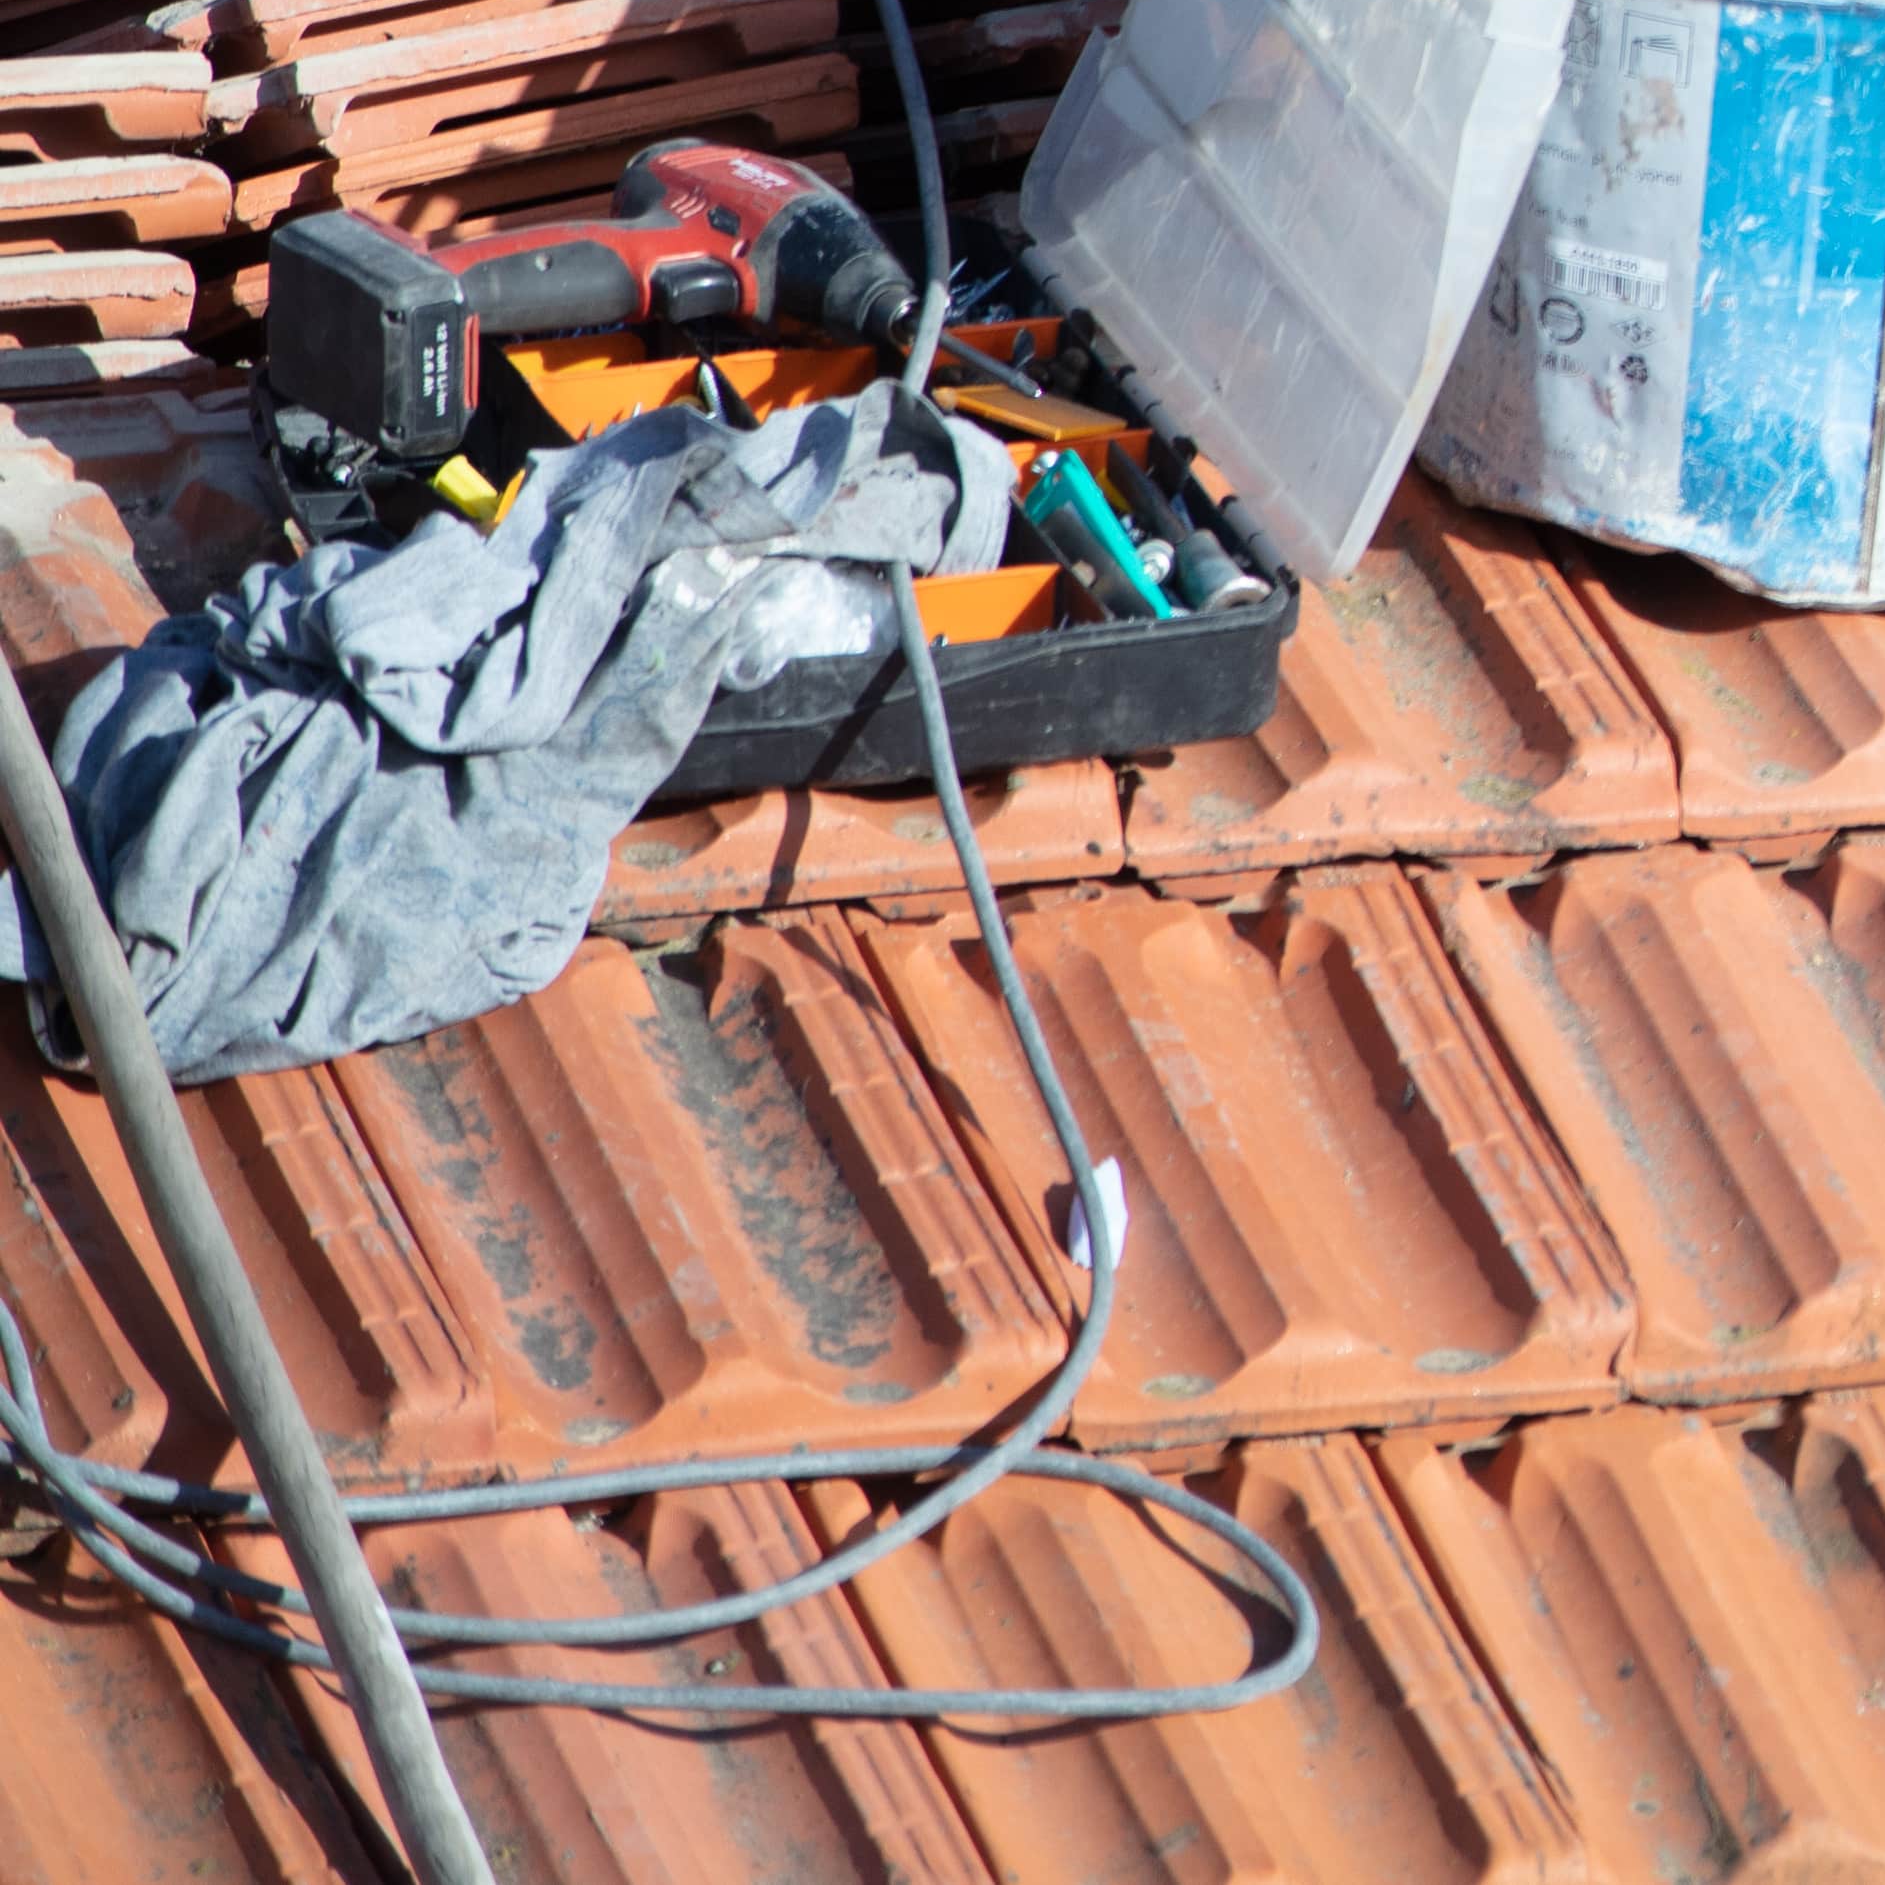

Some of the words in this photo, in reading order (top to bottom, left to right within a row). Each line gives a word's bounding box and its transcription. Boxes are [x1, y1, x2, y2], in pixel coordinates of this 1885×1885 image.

[436, 322, 448, 342] 12
[436, 343, 449, 373] Volt
[422, 375, 435, 398] Ah
